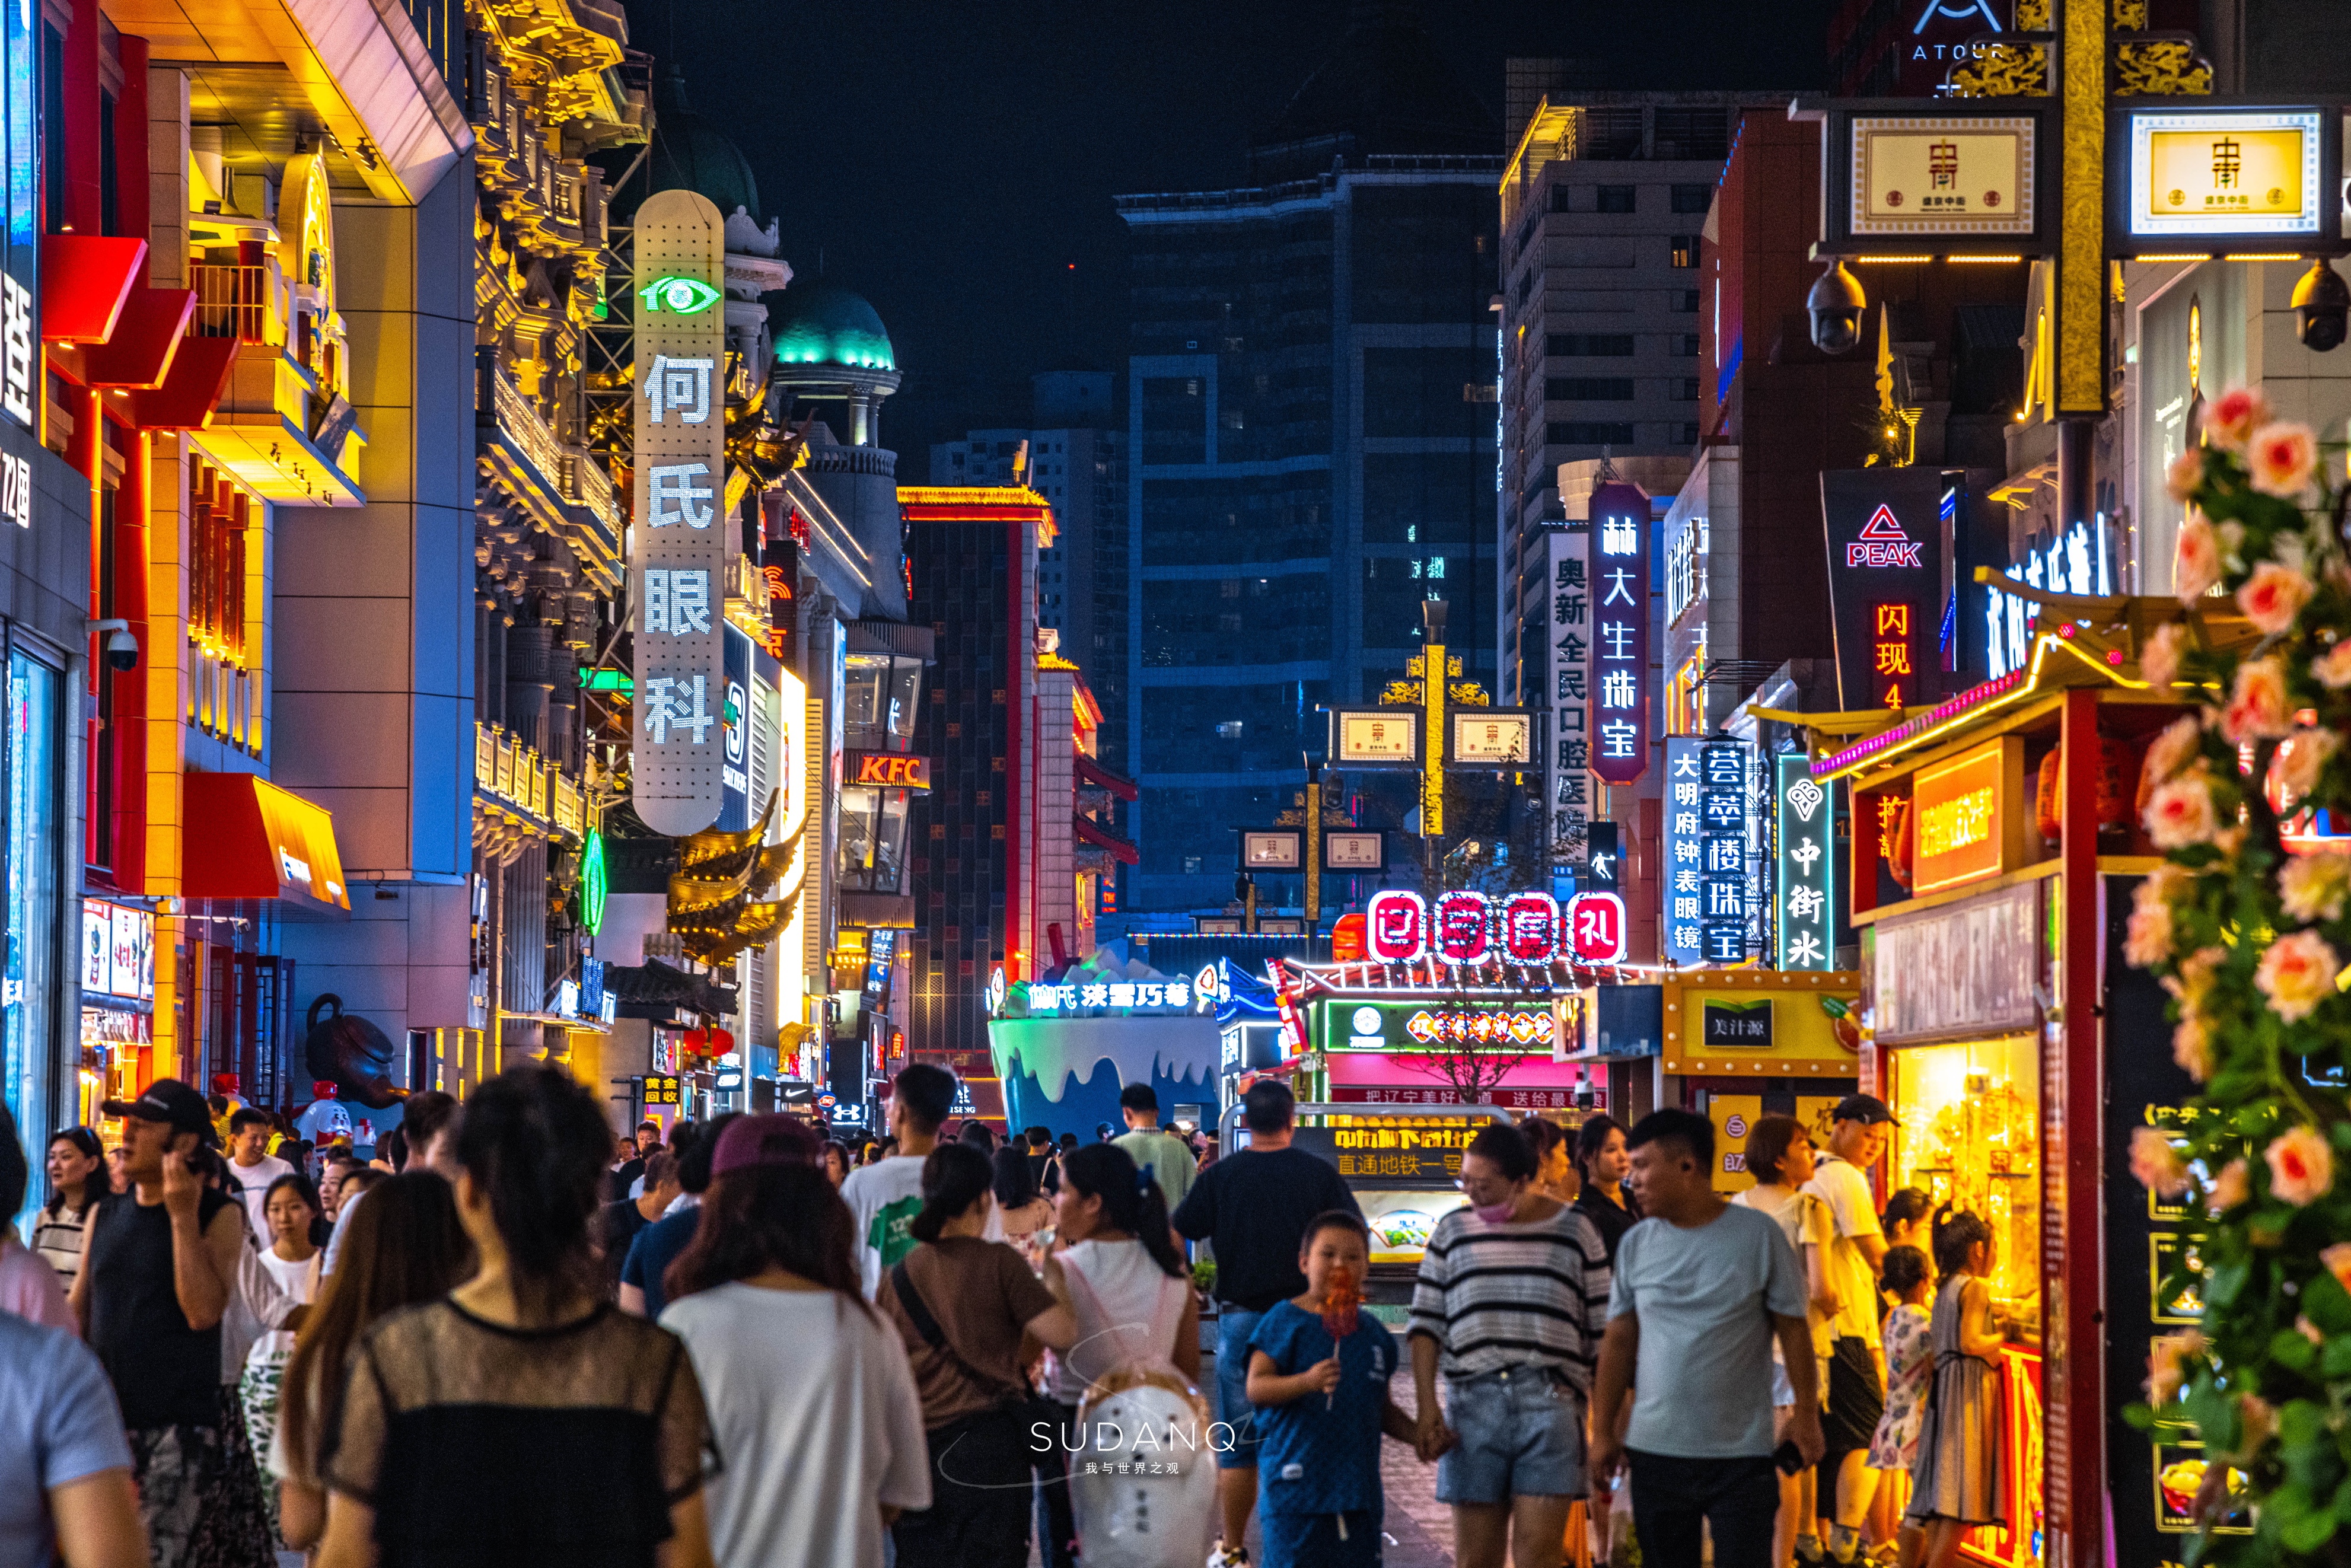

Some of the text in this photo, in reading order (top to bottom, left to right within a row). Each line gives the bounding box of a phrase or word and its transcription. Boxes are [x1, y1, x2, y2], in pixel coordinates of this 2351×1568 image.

[644, 353, 715, 744] 何氏眼科
[1846, 542, 1923, 568] PEAK
[1602, 516, 1637, 758] 林大生珠宝
[1554, 558, 1587, 840] 奥新全民口腔医院
[858, 756, 920, 783] KFC
[1673, 753, 1700, 950] 大明府钟表眼镜
[1708, 750, 1742, 960] 荟萃楼珠宝
[1378, 909, 1616, 948] 辽宁有礼
[1714, 1018, 1764, 1036] 美汁源
[645, 1078, 677, 1090] 黄金
[645, 1091, 677, 1103] 回收
[1338, 1154, 1461, 1176] 直通地铁一号
